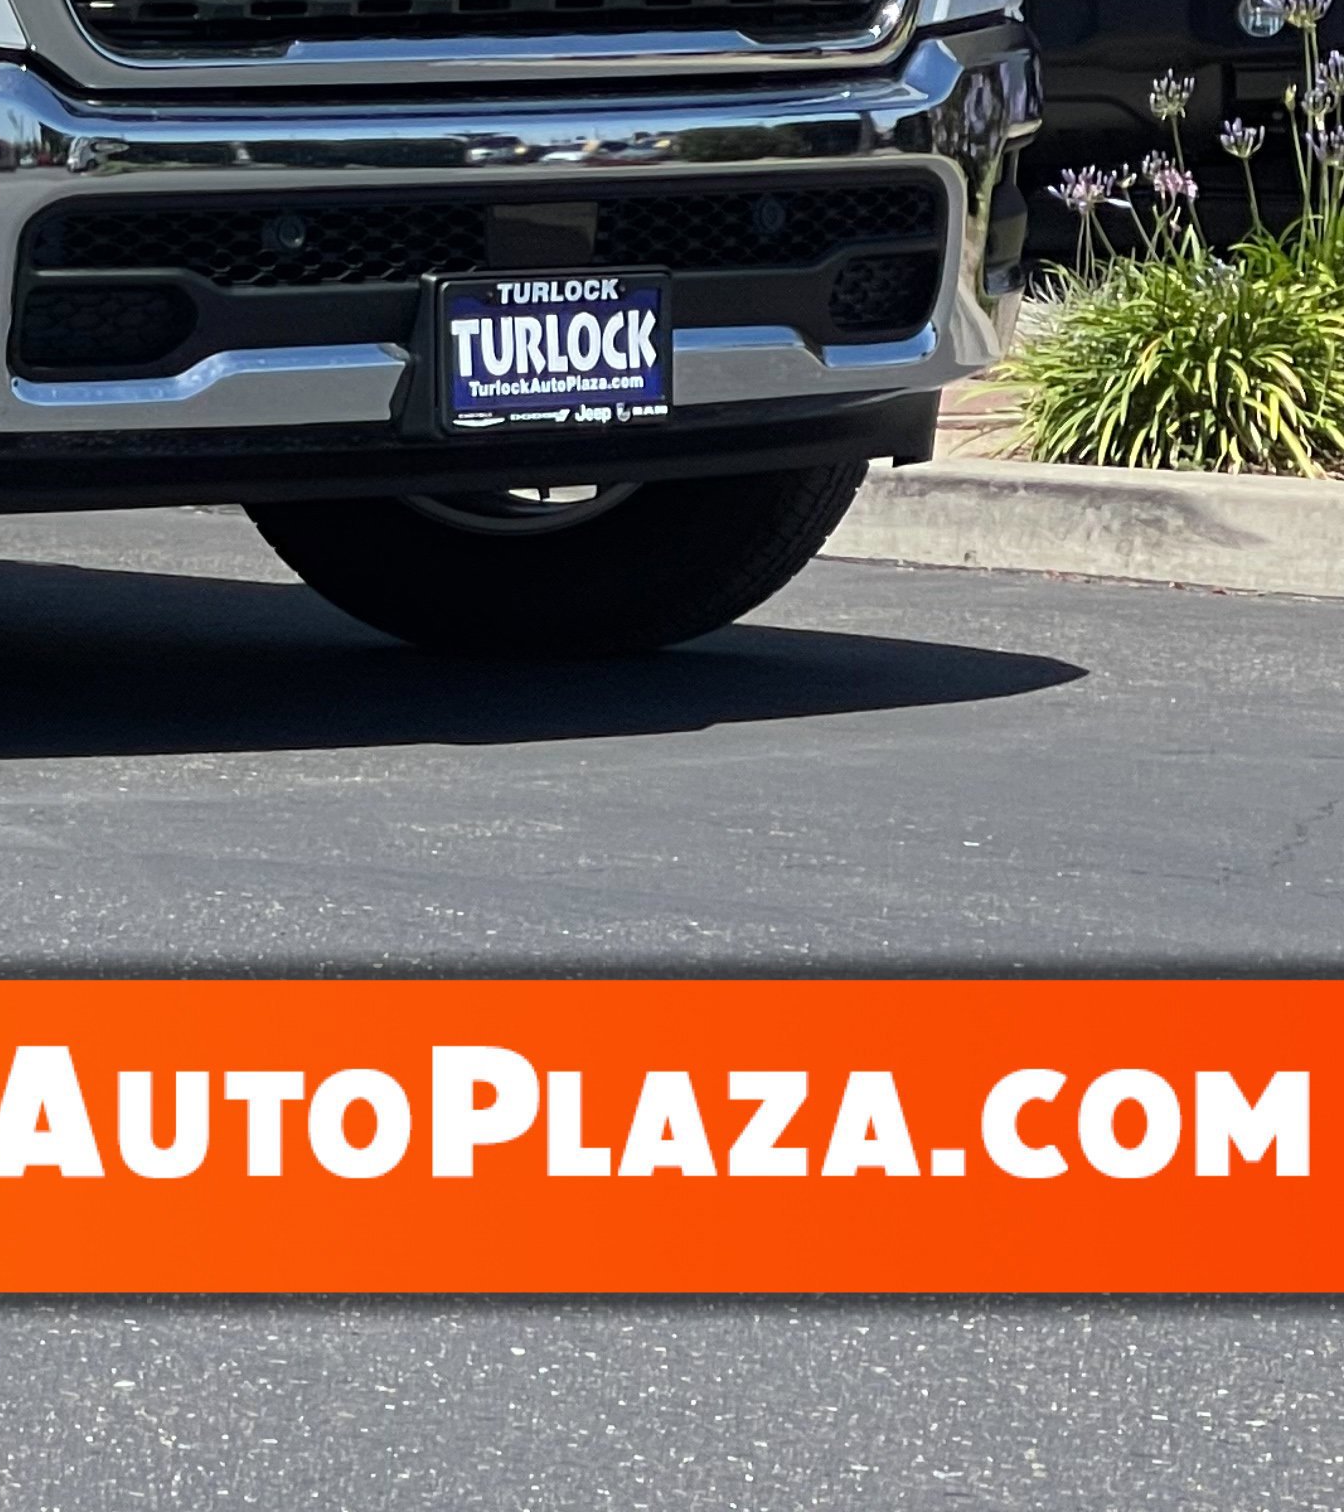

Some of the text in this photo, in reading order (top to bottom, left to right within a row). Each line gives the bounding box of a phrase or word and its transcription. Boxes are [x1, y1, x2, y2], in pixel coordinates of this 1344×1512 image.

[497, 278, 619, 305] TURLOCK
[451, 309, 657, 377] TURLOCK
[469, 375, 645, 398] TurlockAutoPlaza.com
[575, 404, 612, 424] Jeep
